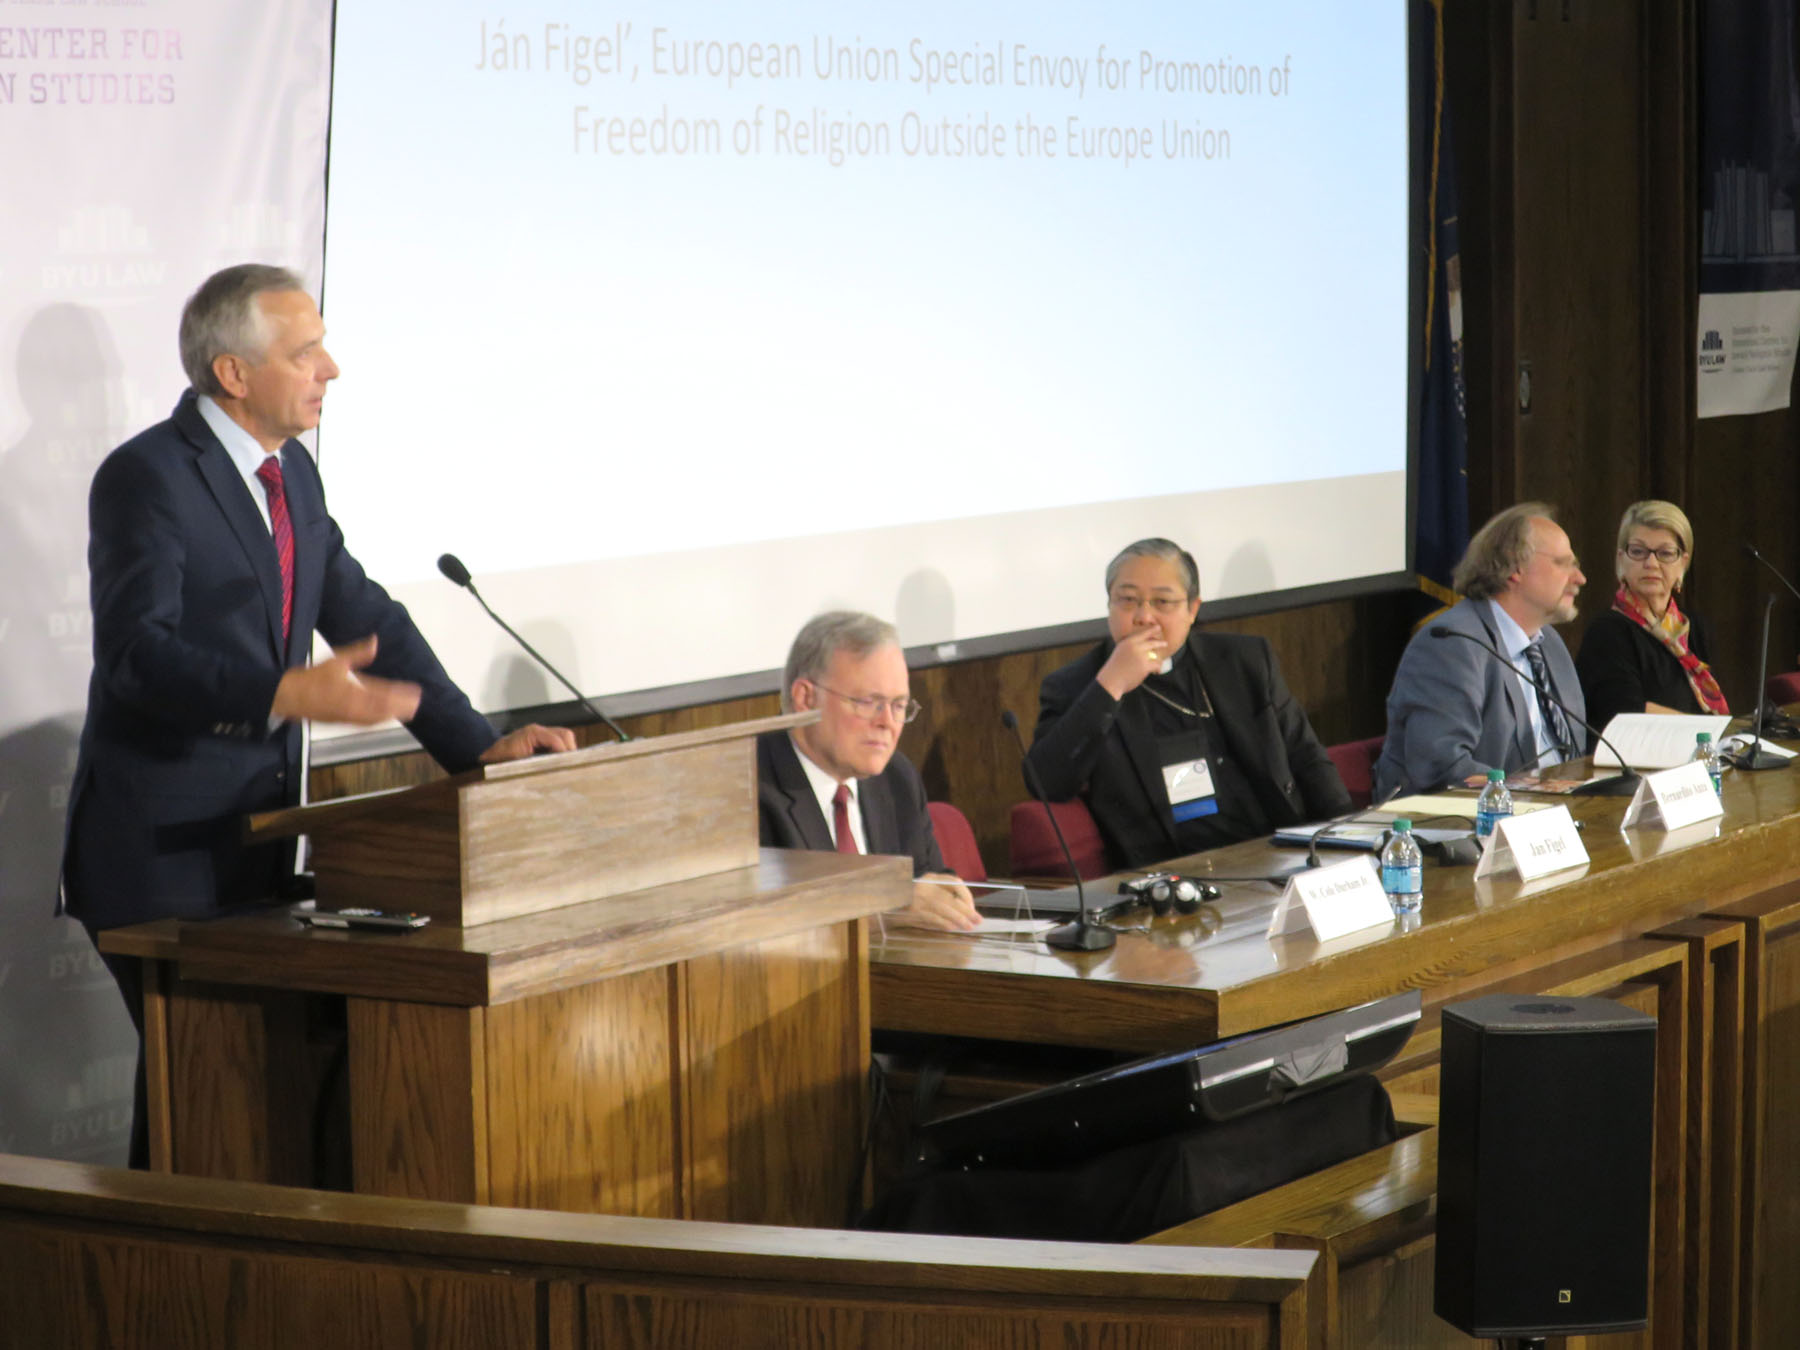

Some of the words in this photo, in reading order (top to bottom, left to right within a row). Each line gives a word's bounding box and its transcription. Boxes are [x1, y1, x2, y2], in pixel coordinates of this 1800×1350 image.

[120, 28, 184, 61] FOR
[475, 17, 531, 72] Ján
[652, 26, 801, 90] European
[814, 35, 899, 82] Union
[909, 37, 1003, 94] Special
[1014, 43, 1088, 100] Envoy
[1096, 43, 1131, 90] for
[1139, 50, 1261, 96] Promotion
[1268, 53, 1292, 97] of
[29, 72, 176, 104] STUDIES
[573, 104, 721, 156] Freedom
[733, 104, 764, 156] of
[775, 107, 890, 168] Religion
[901, 110, 1006, 158] Outside
[1014, 112, 1057, 158] the
[1067, 116, 1153, 168] Europe
[1162, 119, 1230, 160] Union
